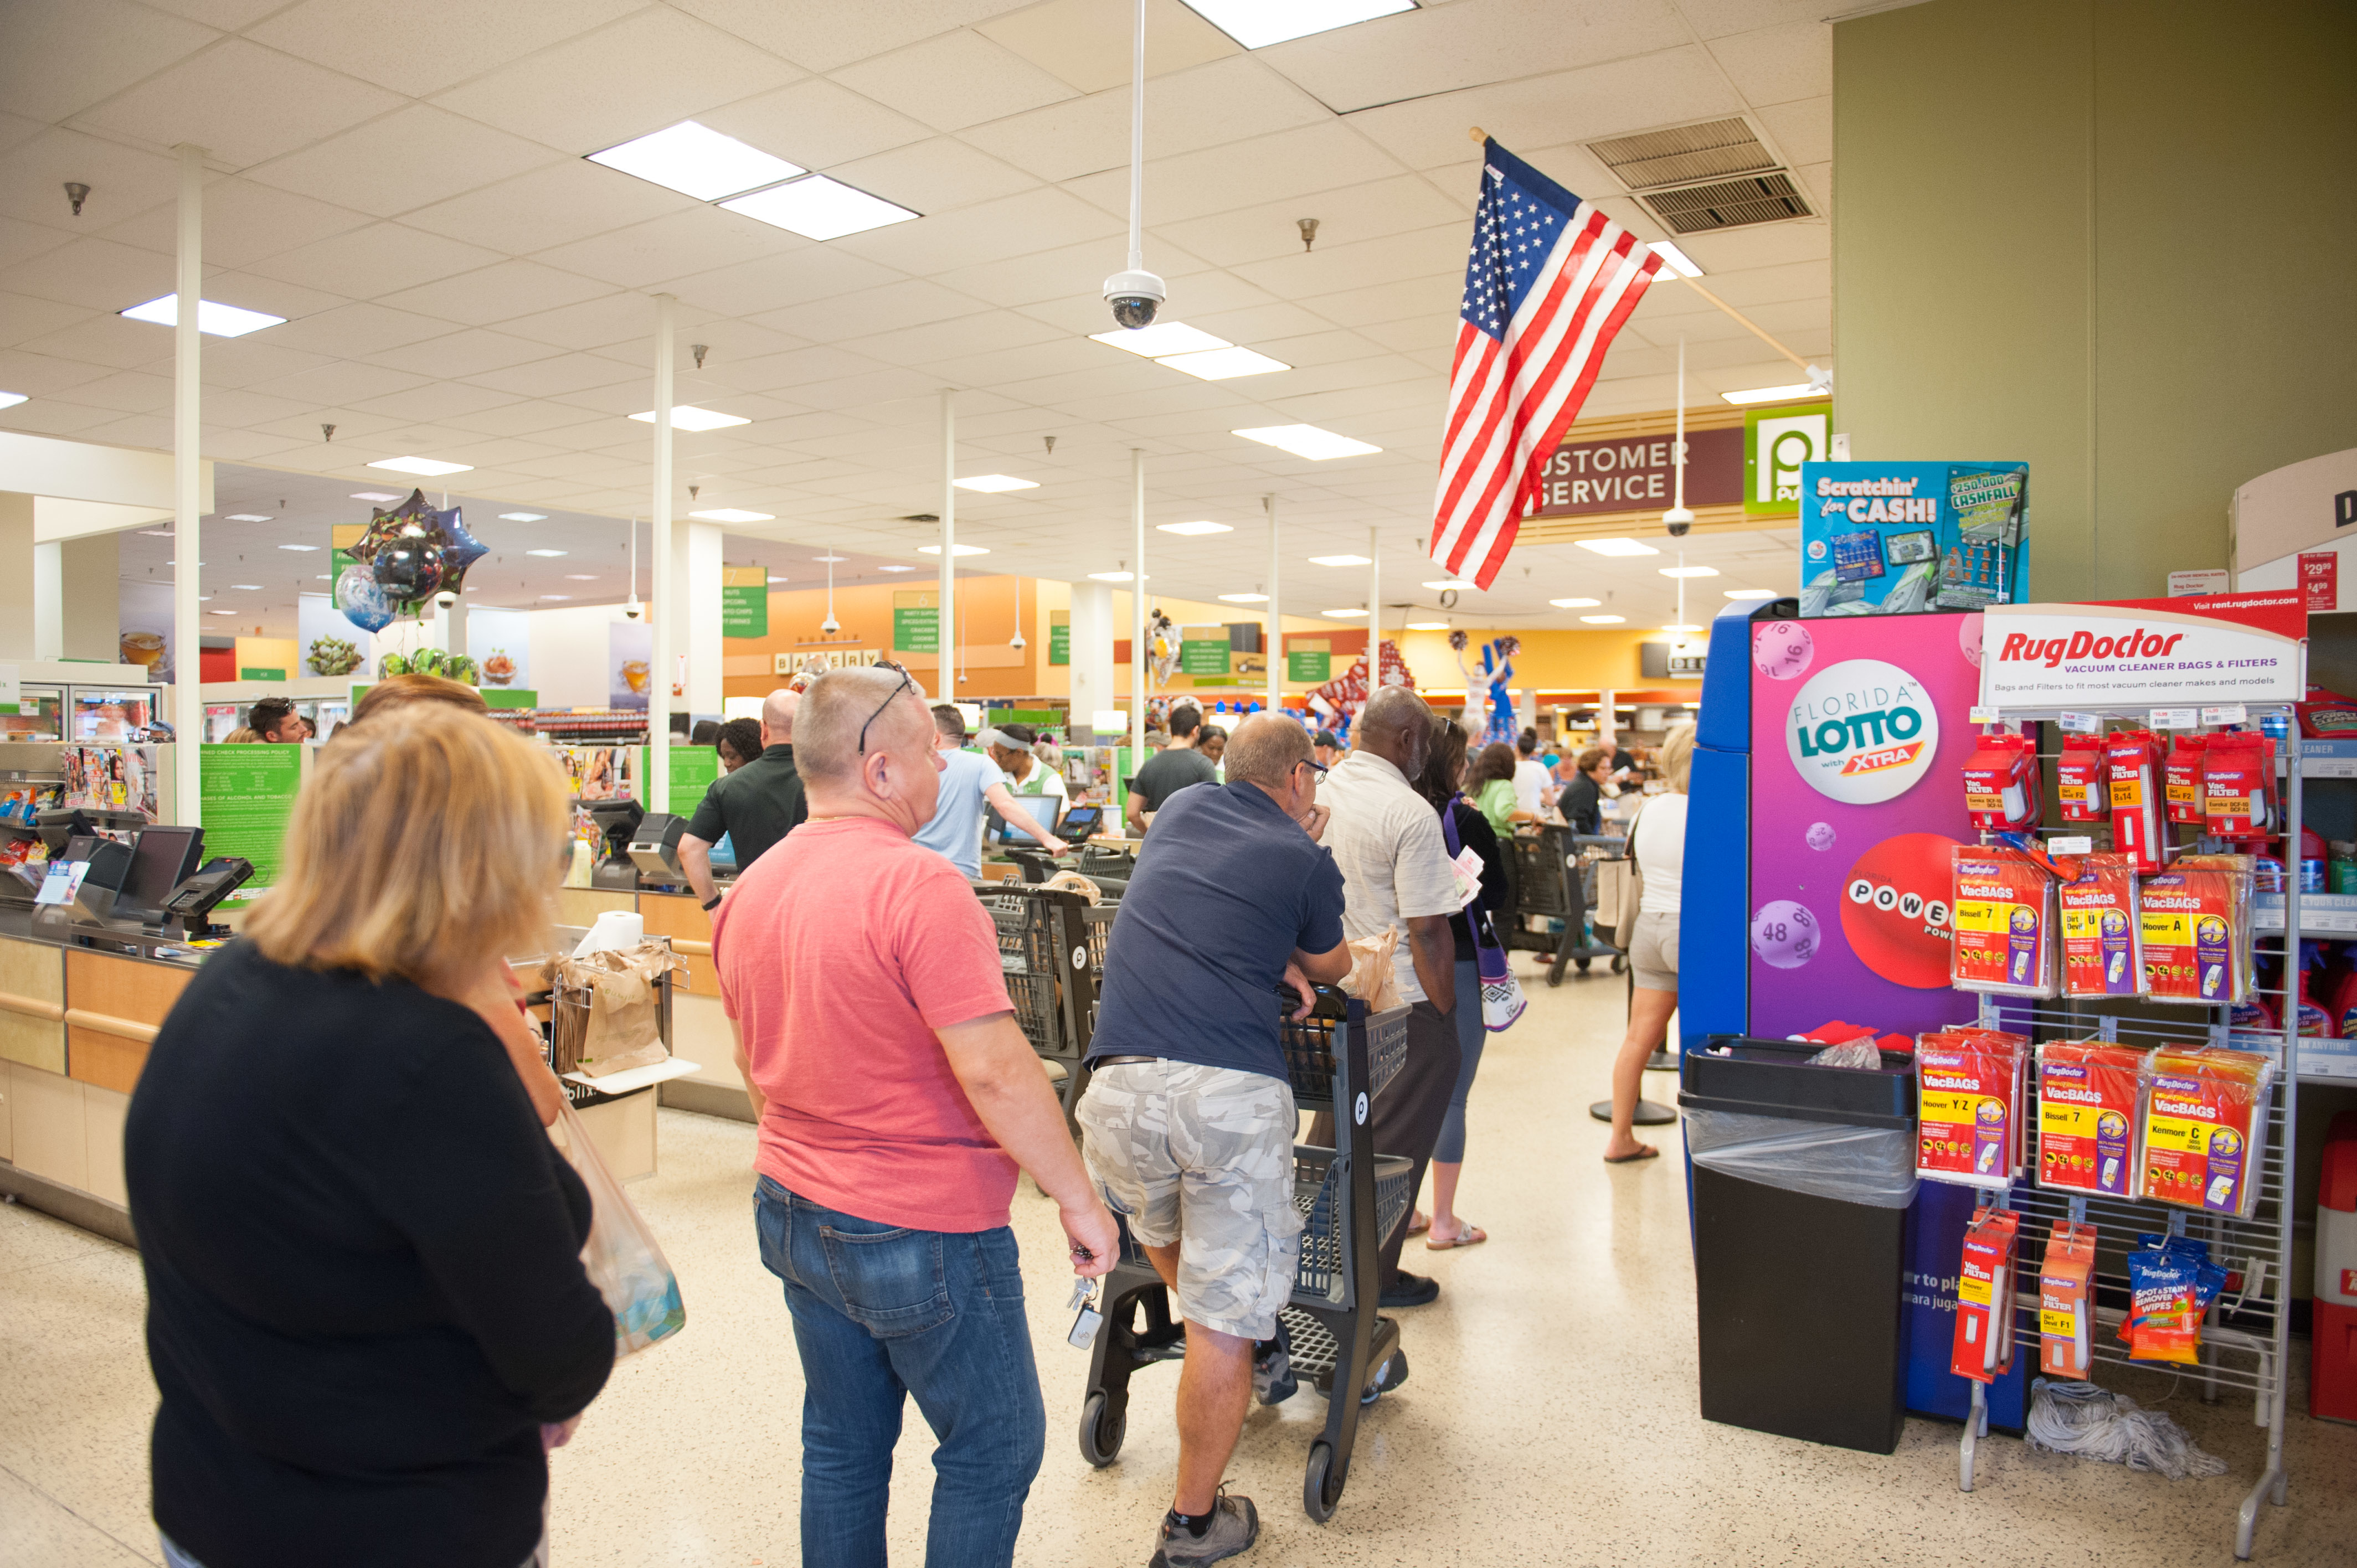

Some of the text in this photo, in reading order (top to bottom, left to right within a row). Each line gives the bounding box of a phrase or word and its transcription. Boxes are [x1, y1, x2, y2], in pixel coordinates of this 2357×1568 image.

[1541, 441, 1689, 478] USTOMER
[1541, 473, 1666, 506] SERVICE
[1816, 477, 1919, 497] Scratchin'
[1952, 476, 2004, 493] $250,000
[1952, 486, 2016, 508] CASHFALL
[1820, 499, 1846, 518] for
[1846, 498, 1937, 523] CASH!
[2212, 597, 2298, 609] rent.rugdoctor.com
[778, 654, 876, 669] BAERY
[2065, 658, 2278, 673] VACUUM CLEANER BAGS & FILTERS
[1995, 684, 2016, 692] Bags
[2240, 677, 2275, 685] models
[1794, 685, 1913, 724] FLORIDA
[1797, 706, 1922, 758] LOTTO
[2302, 745, 2333, 754] LEANER
[1821, 747, 1911, 773] with XTRA
[2112, 771, 2138, 779] FILTER
[1853, 869, 1893, 884] FLORIDA
[1960, 885, 2014, 899] VacBAGS
[1855, 884, 1944, 921] POWE
[2066, 894, 2116, 905] VacBAGS
[2143, 896, 2201, 909] VacBAGS
[2266, 896, 2357, 907] ENHE YOUR CLEA
[1987, 909, 1993, 918] 7
[2088, 915, 2094, 925] U
[1763, 922, 1787, 942] 48
[2143, 920, 2181, 931] Hoover A
[2312, 1041, 2350, 1051] ANYTIME
[1923, 1075, 1980, 1091] VacBAGS
[2046, 1086, 2102, 1103] VacBAGS
[1923, 1100, 1969, 1111] Hoover Y/Z
[2154, 1100, 2216, 1118] VacBAGS
[2045, 1112, 2080, 1122] Bissell 7
[2152, 1125, 2199, 1139] Kenmore C
[1964, 1261, 1979, 1271] Vac
[1964, 1267, 1990, 1280] FILTER
[1922, 1274, 1960, 1292] to pla
[1963, 1281, 1983, 1291] Hoover
[2043, 1293, 2060, 1302] Vac
[2135, 1288, 2158, 1299] SPOT
[2135, 1294, 2173, 1307] REMOVER
[1912, 1294, 1958, 1312] ara juga
[2043, 1300, 2072, 1312] FILTER
[2142, 1302, 2171, 1313] WIPES
[2060, 1321, 2070, 1329] F1
